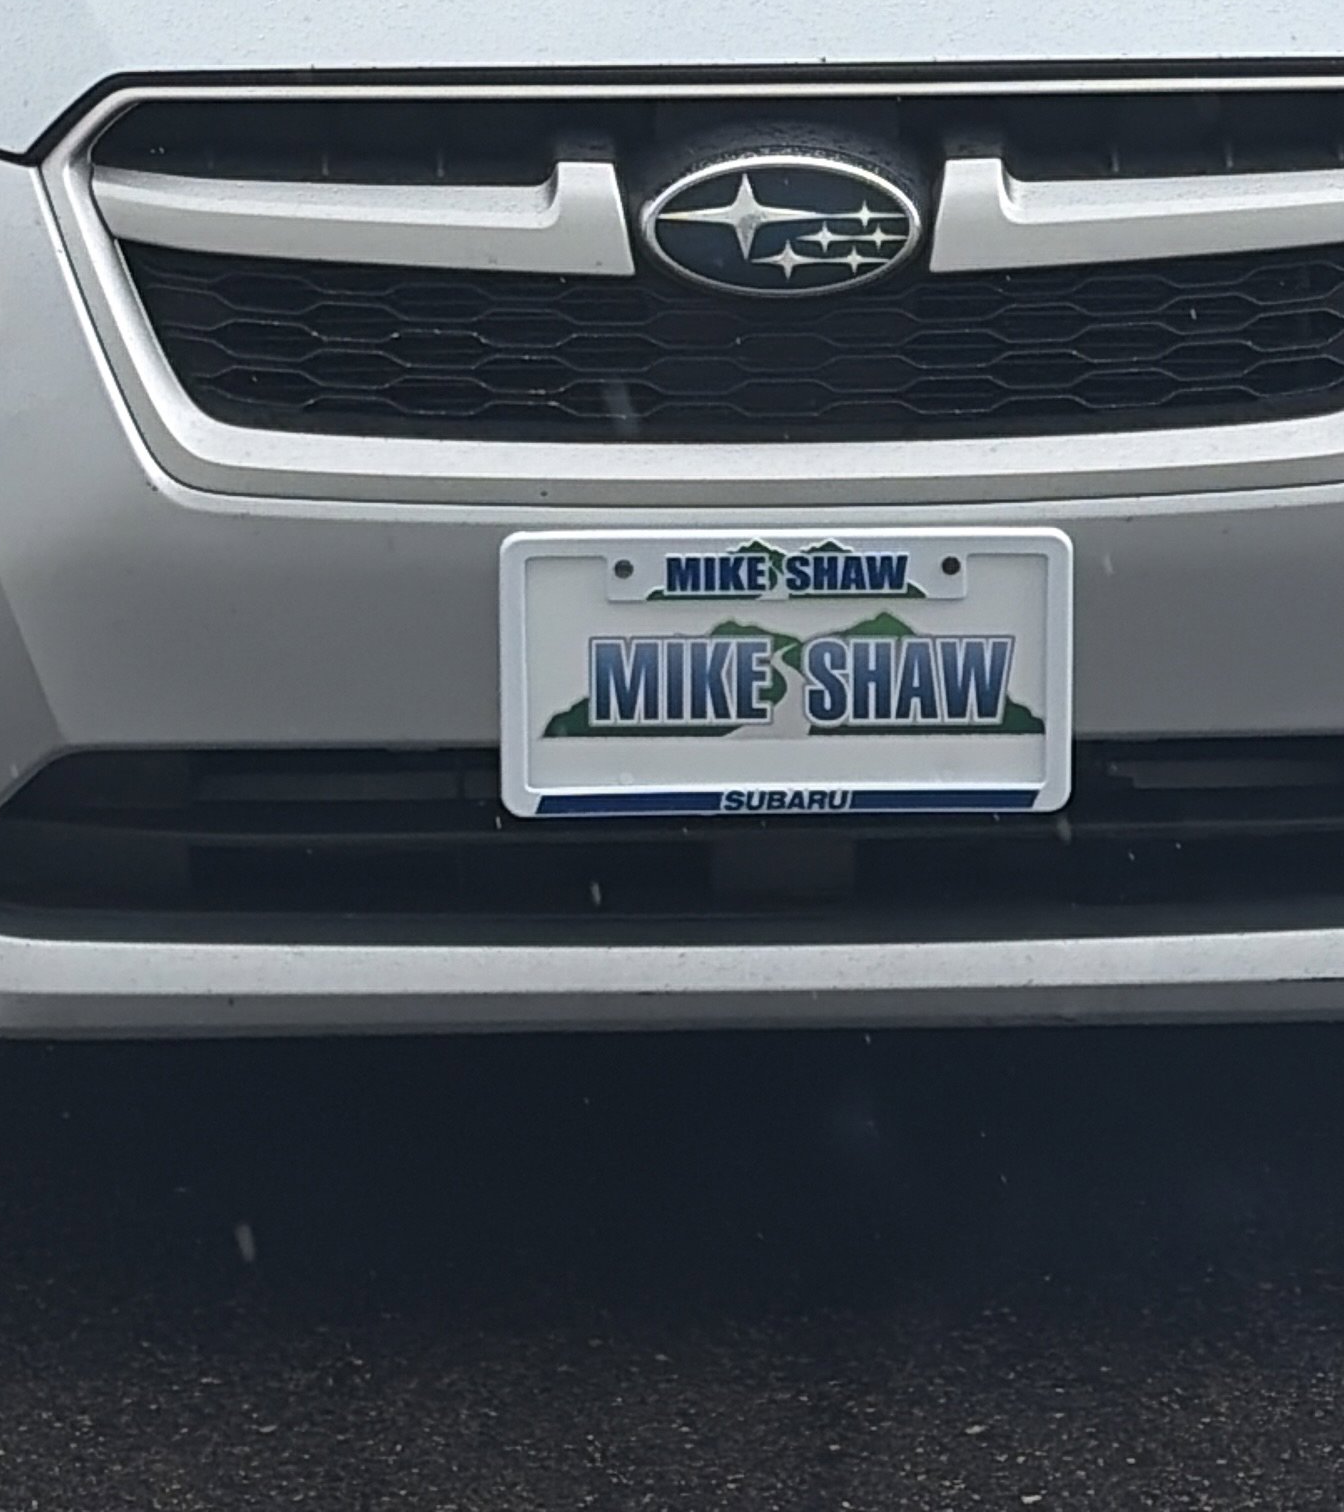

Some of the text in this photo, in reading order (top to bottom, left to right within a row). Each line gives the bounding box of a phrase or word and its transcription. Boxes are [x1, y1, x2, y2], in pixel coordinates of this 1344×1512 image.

[666, 554, 908, 592] MIKE SHAW
[592, 638, 1012, 724] MIKE SHAW
[723, 790, 849, 811] SUBARU
